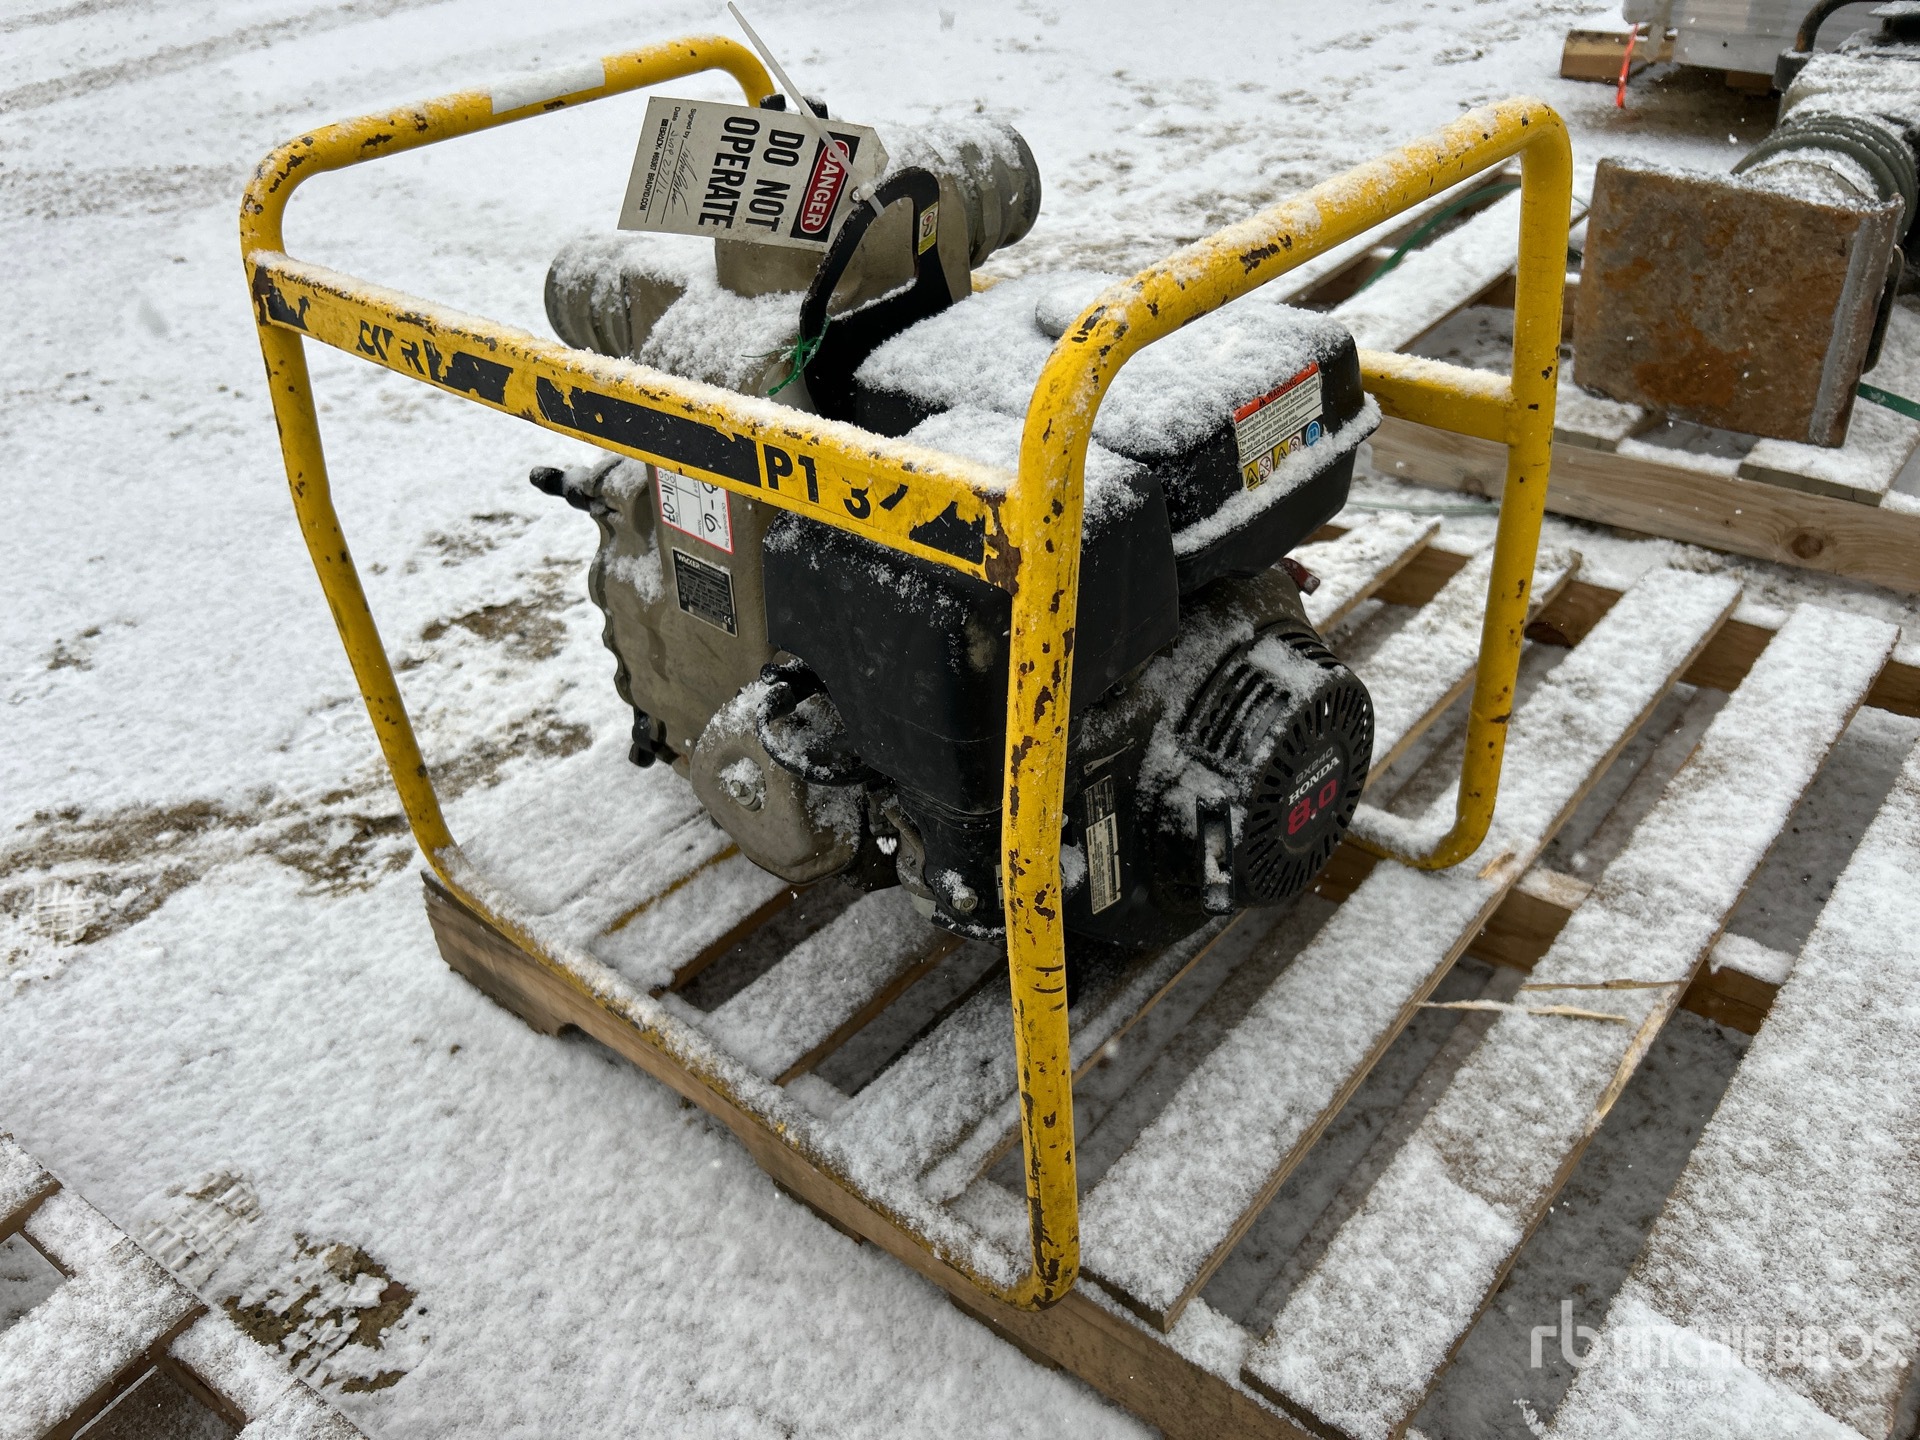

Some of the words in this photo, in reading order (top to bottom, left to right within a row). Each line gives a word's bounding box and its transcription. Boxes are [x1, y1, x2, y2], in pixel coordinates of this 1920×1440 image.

[672, 106, 681, 122] Date
[683, 131, 691, 139] by
[686, 108, 697, 130] Signed
[763, 129, 805, 167] DO
[698, 116, 760, 229] OPERATE
[804, 146, 845, 226] DANGER
[745, 179, 791, 232] NOT
[1288, 756, 1340, 806] HONDA
[1295, 746, 1334, 785] GX240
[1287, 778, 1338, 835] 8.0
